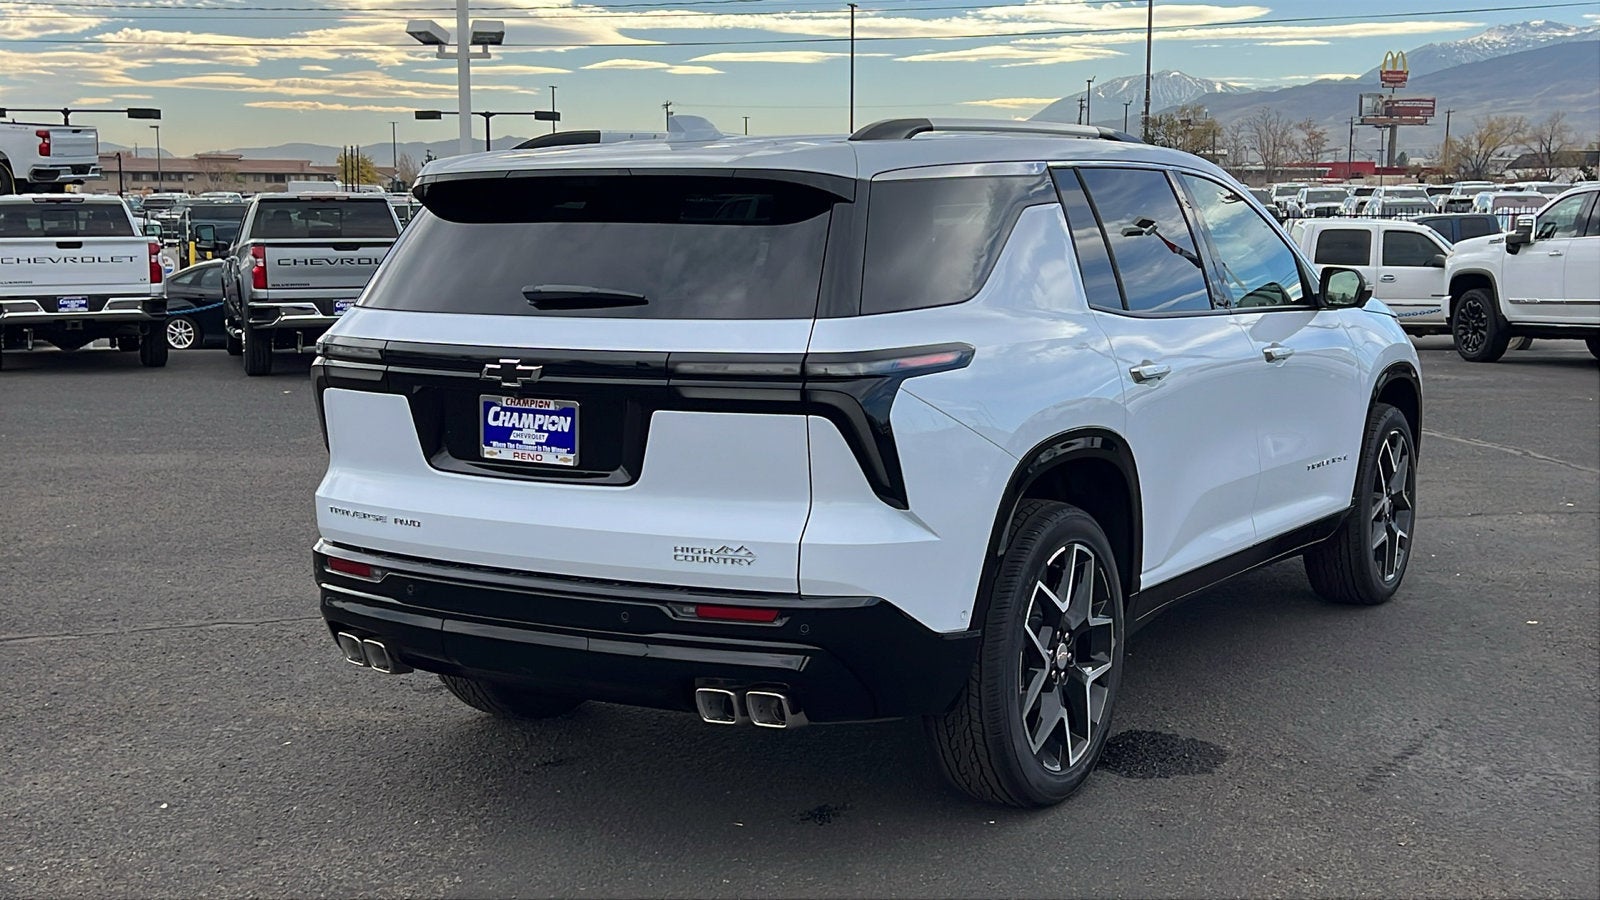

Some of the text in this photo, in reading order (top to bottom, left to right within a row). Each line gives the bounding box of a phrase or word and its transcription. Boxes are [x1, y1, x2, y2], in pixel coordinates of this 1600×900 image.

[1, 255, 138, 265] CHEVROLET
[505, 397, 551, 409] CHAMPION
[487, 406, 572, 433] CHAMPION
[512, 432, 546, 441] CHEVROLET
[512, 451, 543, 462] RENO
[329, 506, 421, 528] TRAVERSE AWD
[673, 545, 714, 555] HIGH
[673, 554, 757, 566] COUNTRY
